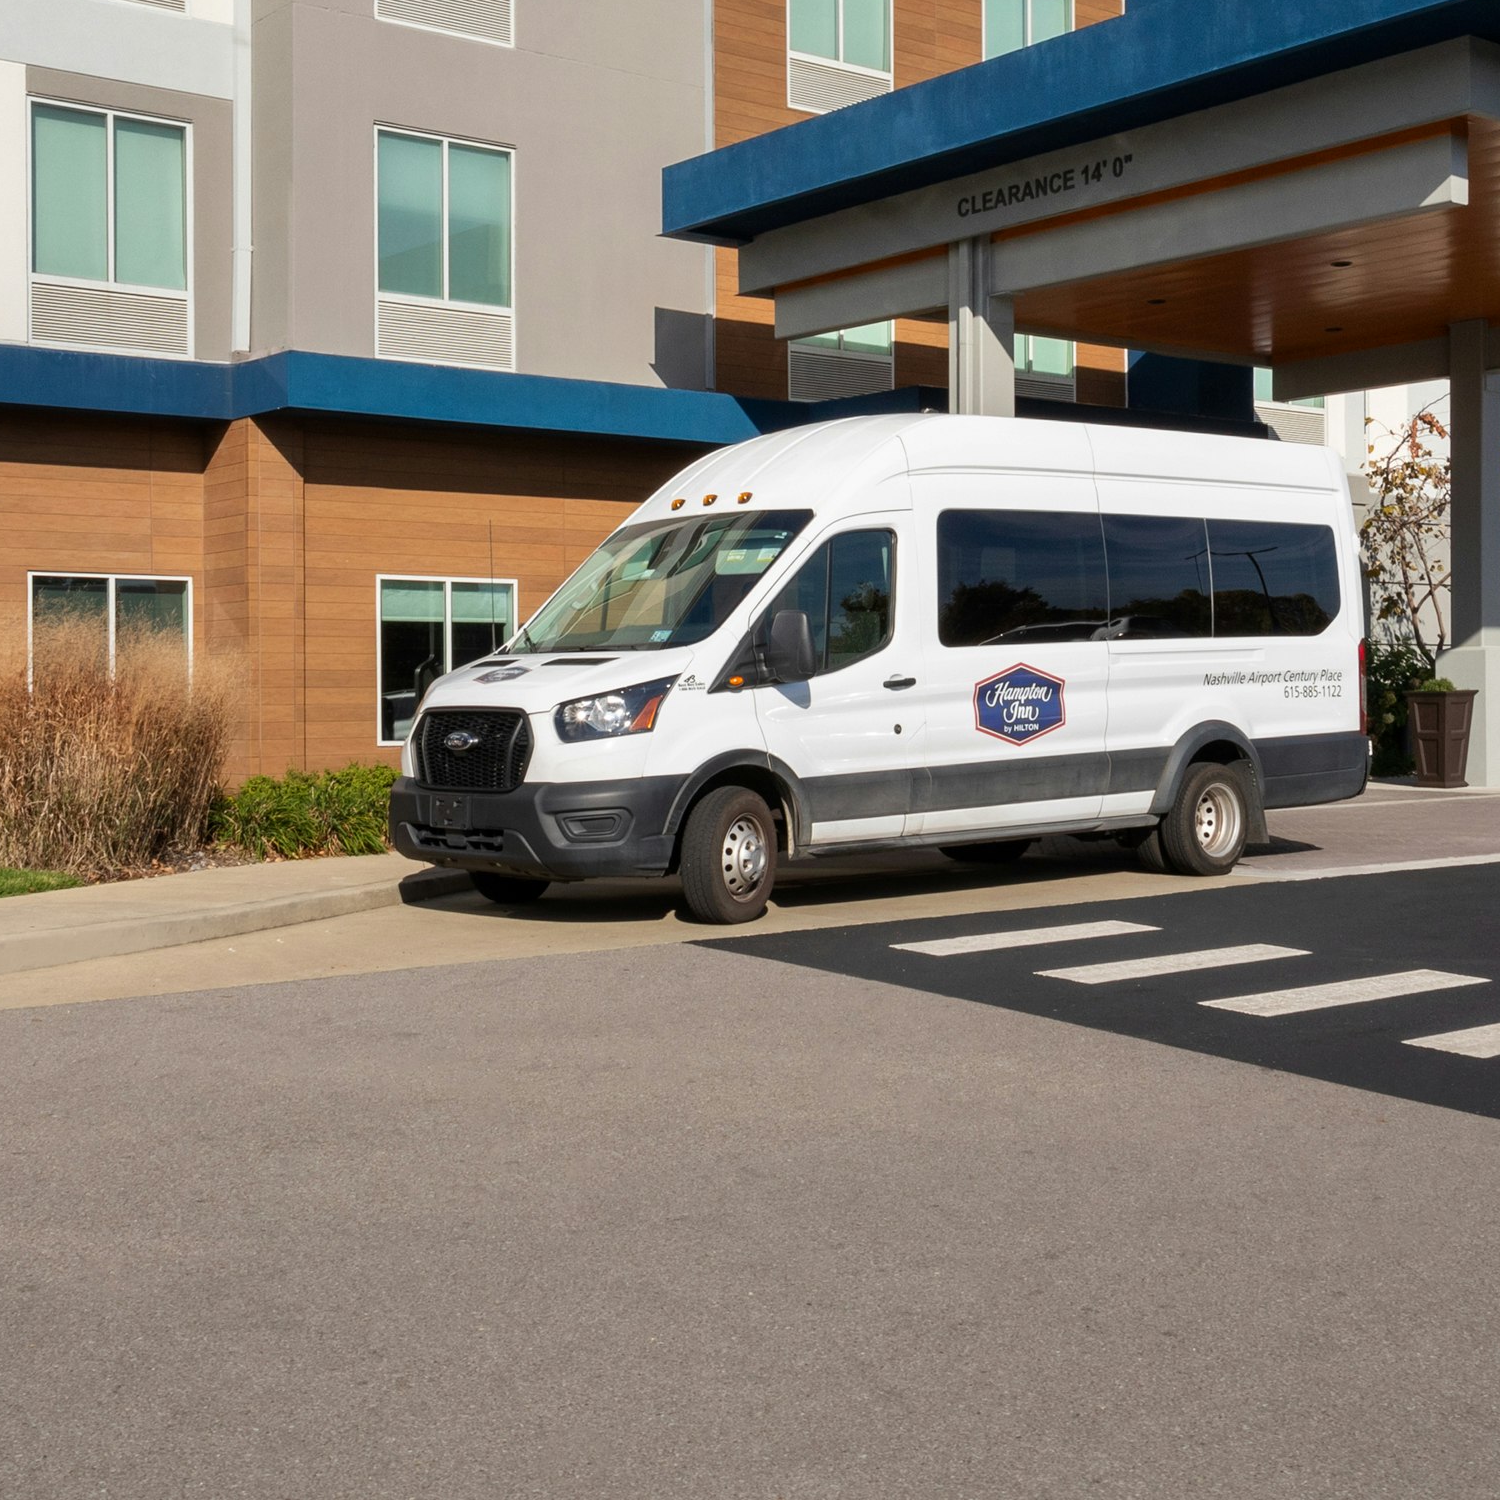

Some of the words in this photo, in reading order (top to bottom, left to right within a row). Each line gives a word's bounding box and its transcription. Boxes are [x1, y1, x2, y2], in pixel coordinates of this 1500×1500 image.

[957, 169, 1076, 217] CLEARANCE
[1081, 161, 1108, 186] 14'
[1203, 671, 1246, 686] Nashville
[1248, 671, 1282, 686] Airport
[1283, 670, 1318, 684] Century
[1320, 669, 1342, 682] Place
[985, 681, 1052, 707] Hampton
[1284, 685, 1342, 699] 615-885-1122
[1003, 701, 1039, 723] Inn
[1004, 725, 1012, 734] by
[1013, 723, 1039, 732] HILTON
